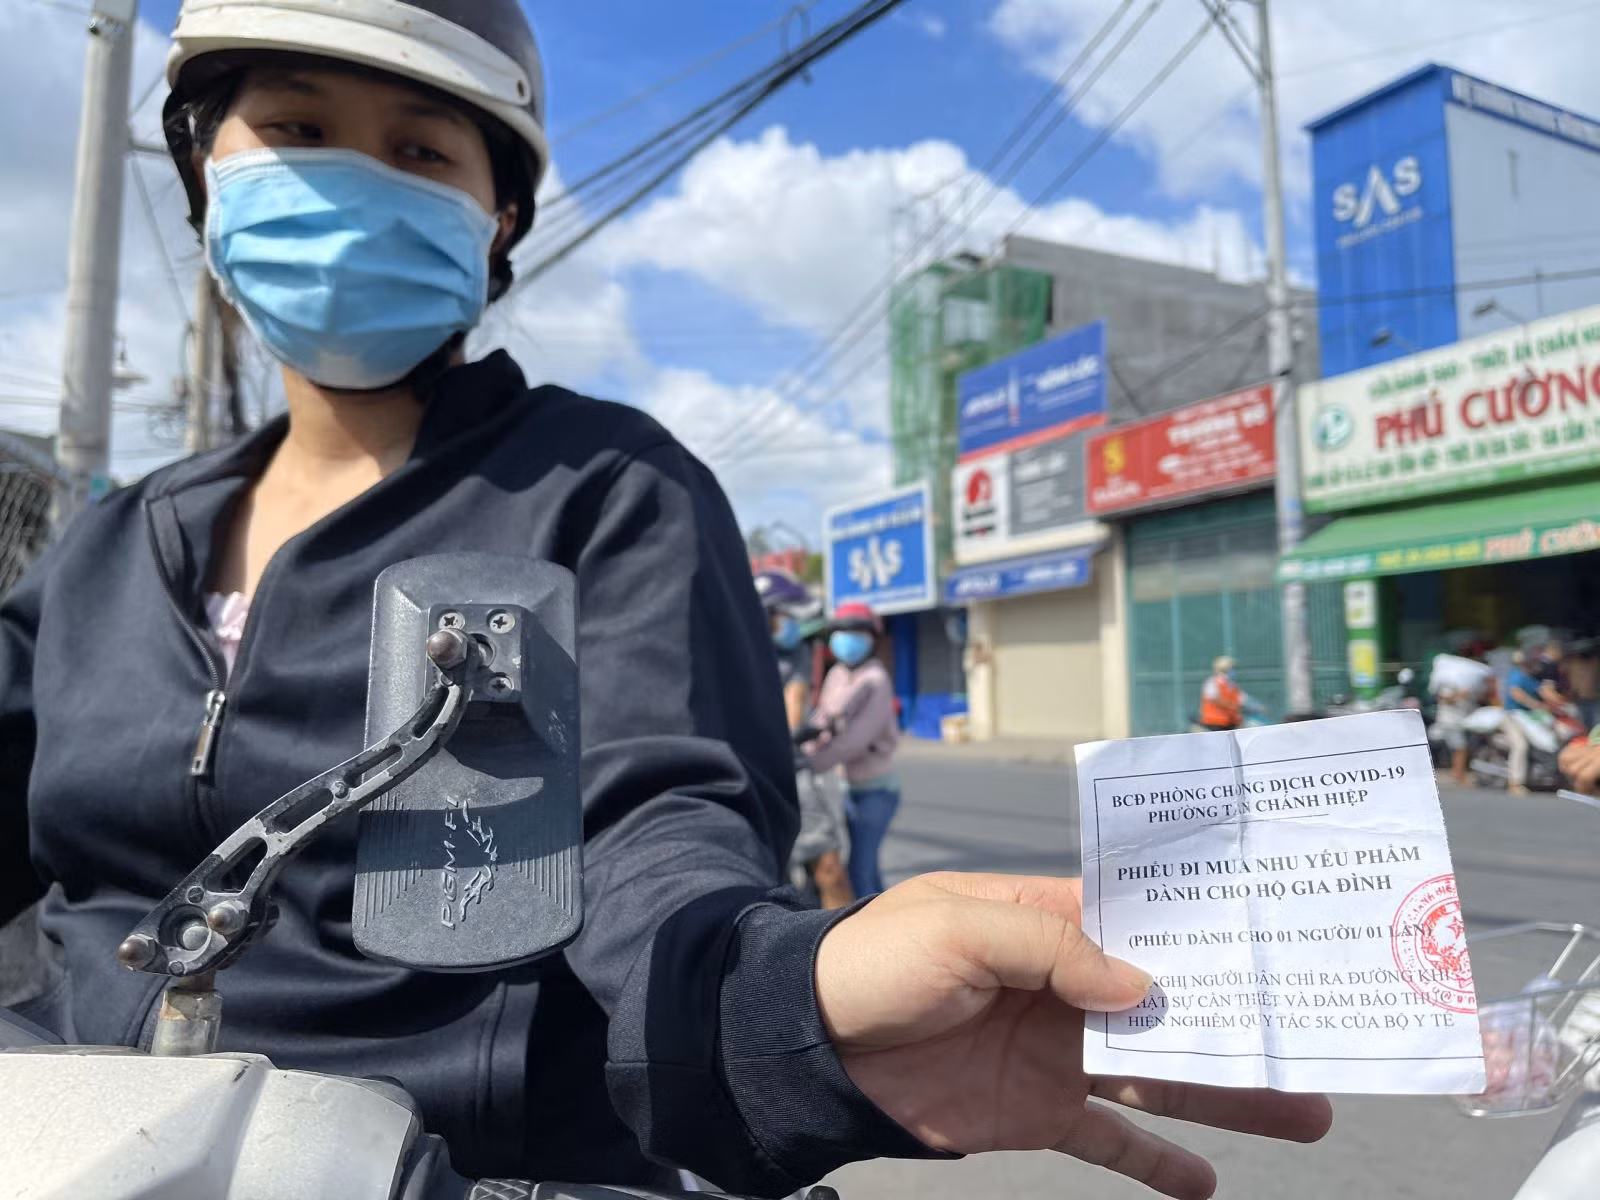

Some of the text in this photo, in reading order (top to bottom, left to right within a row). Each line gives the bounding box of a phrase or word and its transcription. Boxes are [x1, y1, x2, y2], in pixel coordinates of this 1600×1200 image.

[1375, 389, 1443, 449] PHÚ
[1112, 793, 1145, 808] BCĐ
[1150, 786, 1206, 804] PHÒNG
[1270, 775, 1315, 794] DỊCH
[1320, 765, 1405, 787] COVID-19
[1148, 804, 1218, 823] PHƯỜNG
[1255, 791, 1320, 812] CHÁNH
[1324, 788, 1368, 807] HIỆP
[440, 795, 458, 930] PGM-FI
[1118, 860, 1174, 880] PHIẾU
[1180, 861, 1199, 876] ĐI
[1205, 859, 1251, 875] MUA
[1255, 855, 1298, 872] NHU
[1304, 849, 1348, 869] YẾU
[1146, 873, 1392, 902] DÀNH CHO HỘ GIA ĐÌNH
[1187, 929, 1233, 946] DÀNH
[1237, 930, 1273, 944] CHO
[1277, 930, 1292, 943] 01
[1366, 925, 1383, 939] 01
[1192, 970, 1243, 987] NGƯỜI
[1247, 969, 1281, 986] DÂN
[1286, 970, 1315, 986] CHỈ
[1320, 972, 1344, 986] RA
[1348, 968, 1414, 985] ĐƯỜNG
[1418, 969, 1451, 983] KHI
[1172, 994, 1194, 1010] SỰ
[1284, 991, 1310, 1007] VÀ
[1313, 990, 1354, 1007] ĐẢM
[1359, 989, 1397, 1006] BẢO
[1128, 1014, 1165, 1029] HIỆN
[1171, 1013, 1235, 1028] NGHIÊM
[1239, 1013, 1272, 1029] QUY
[1315, 1015, 1337, 1029] 5K
[1341, 1012, 1380, 1029] CỦA
[1384, 1012, 1409, 1031] BỘ
[1413, 1014, 1425, 1027] Y
[1430, 1010, 1455, 1027] TẾ
